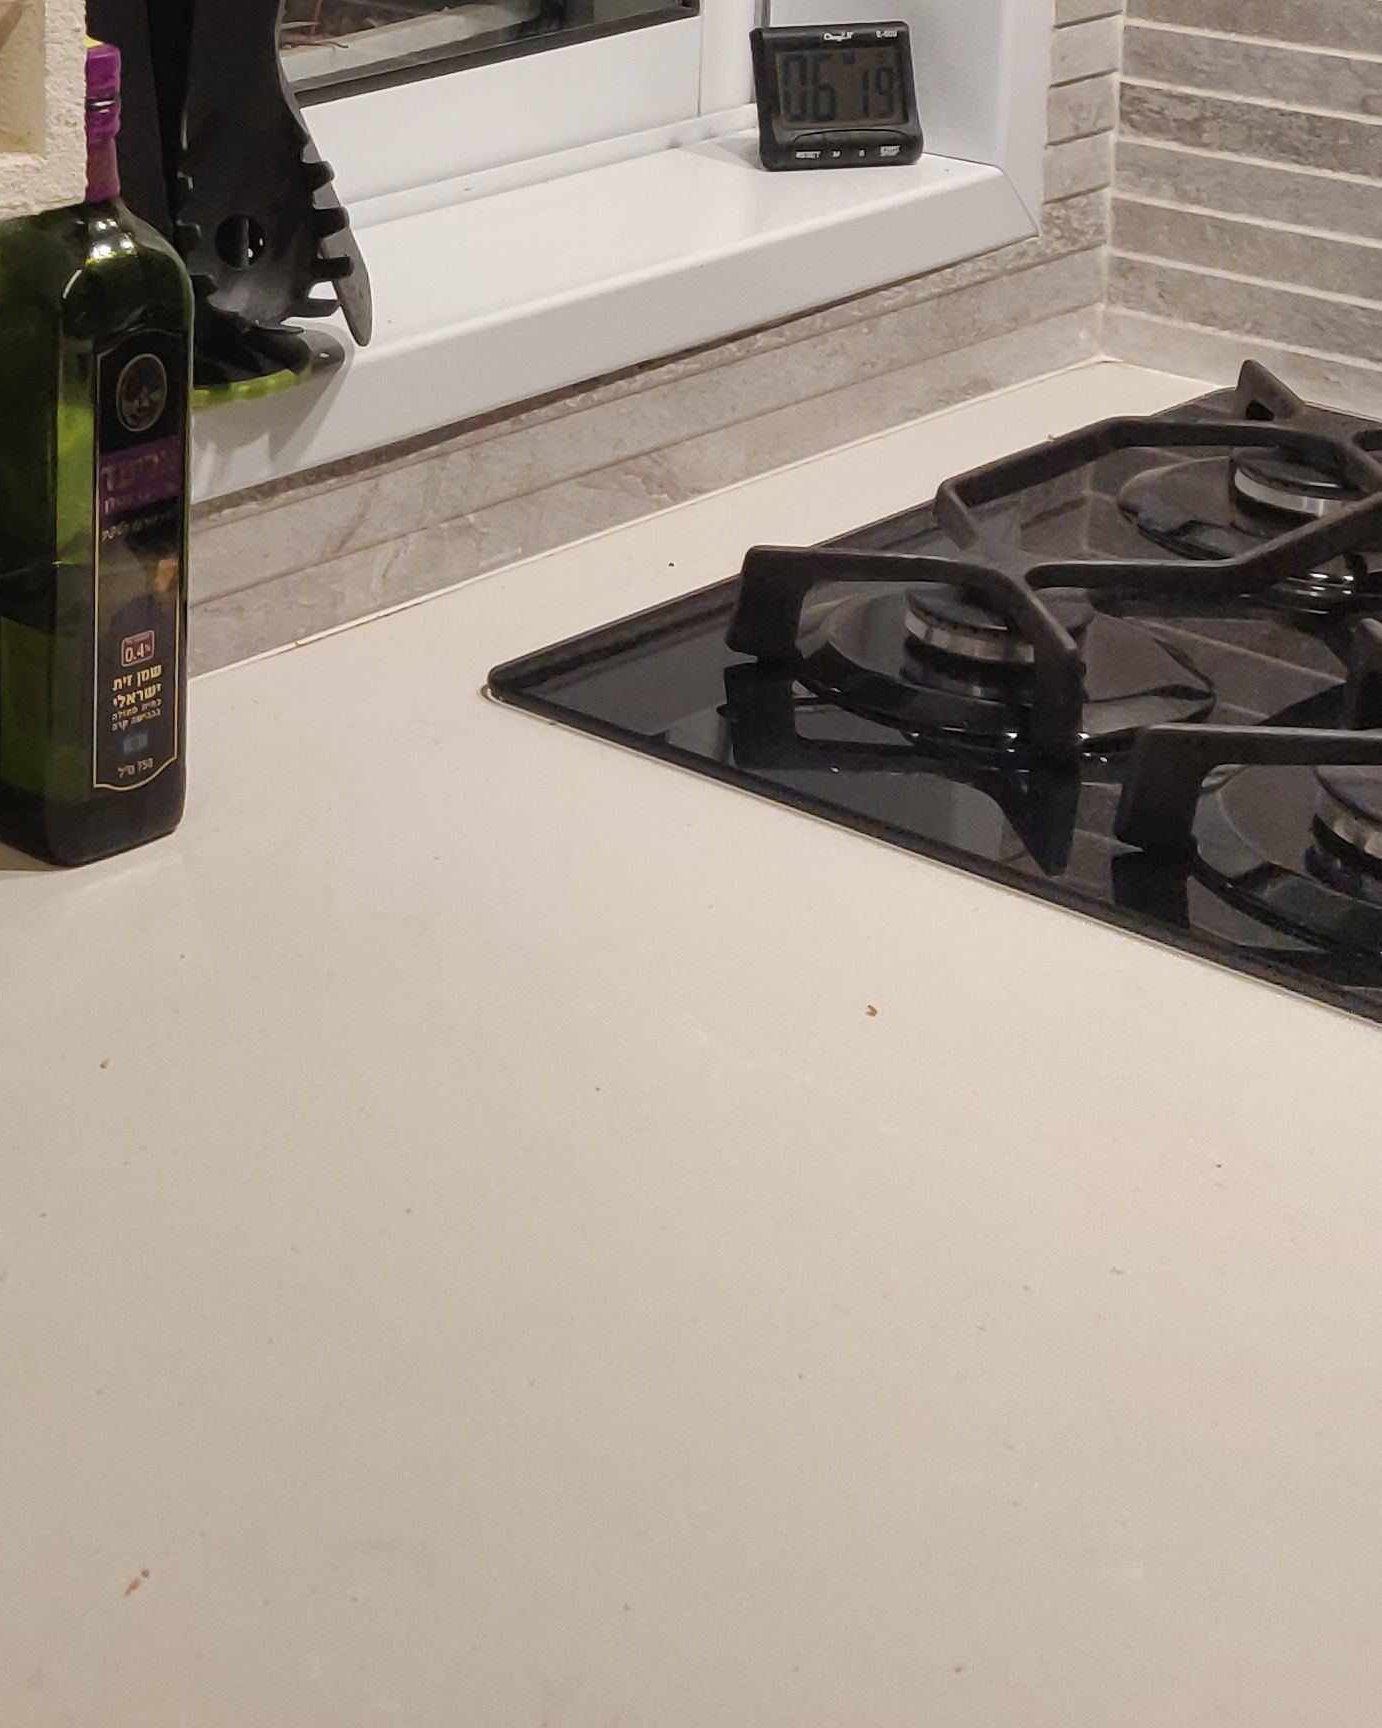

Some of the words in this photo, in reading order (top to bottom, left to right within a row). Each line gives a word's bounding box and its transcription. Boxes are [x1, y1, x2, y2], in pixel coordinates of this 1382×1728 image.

[112, 674, 133, 692] זית
[136, 664, 162, 687] שמן
[112, 683, 162, 709] ישראלי
